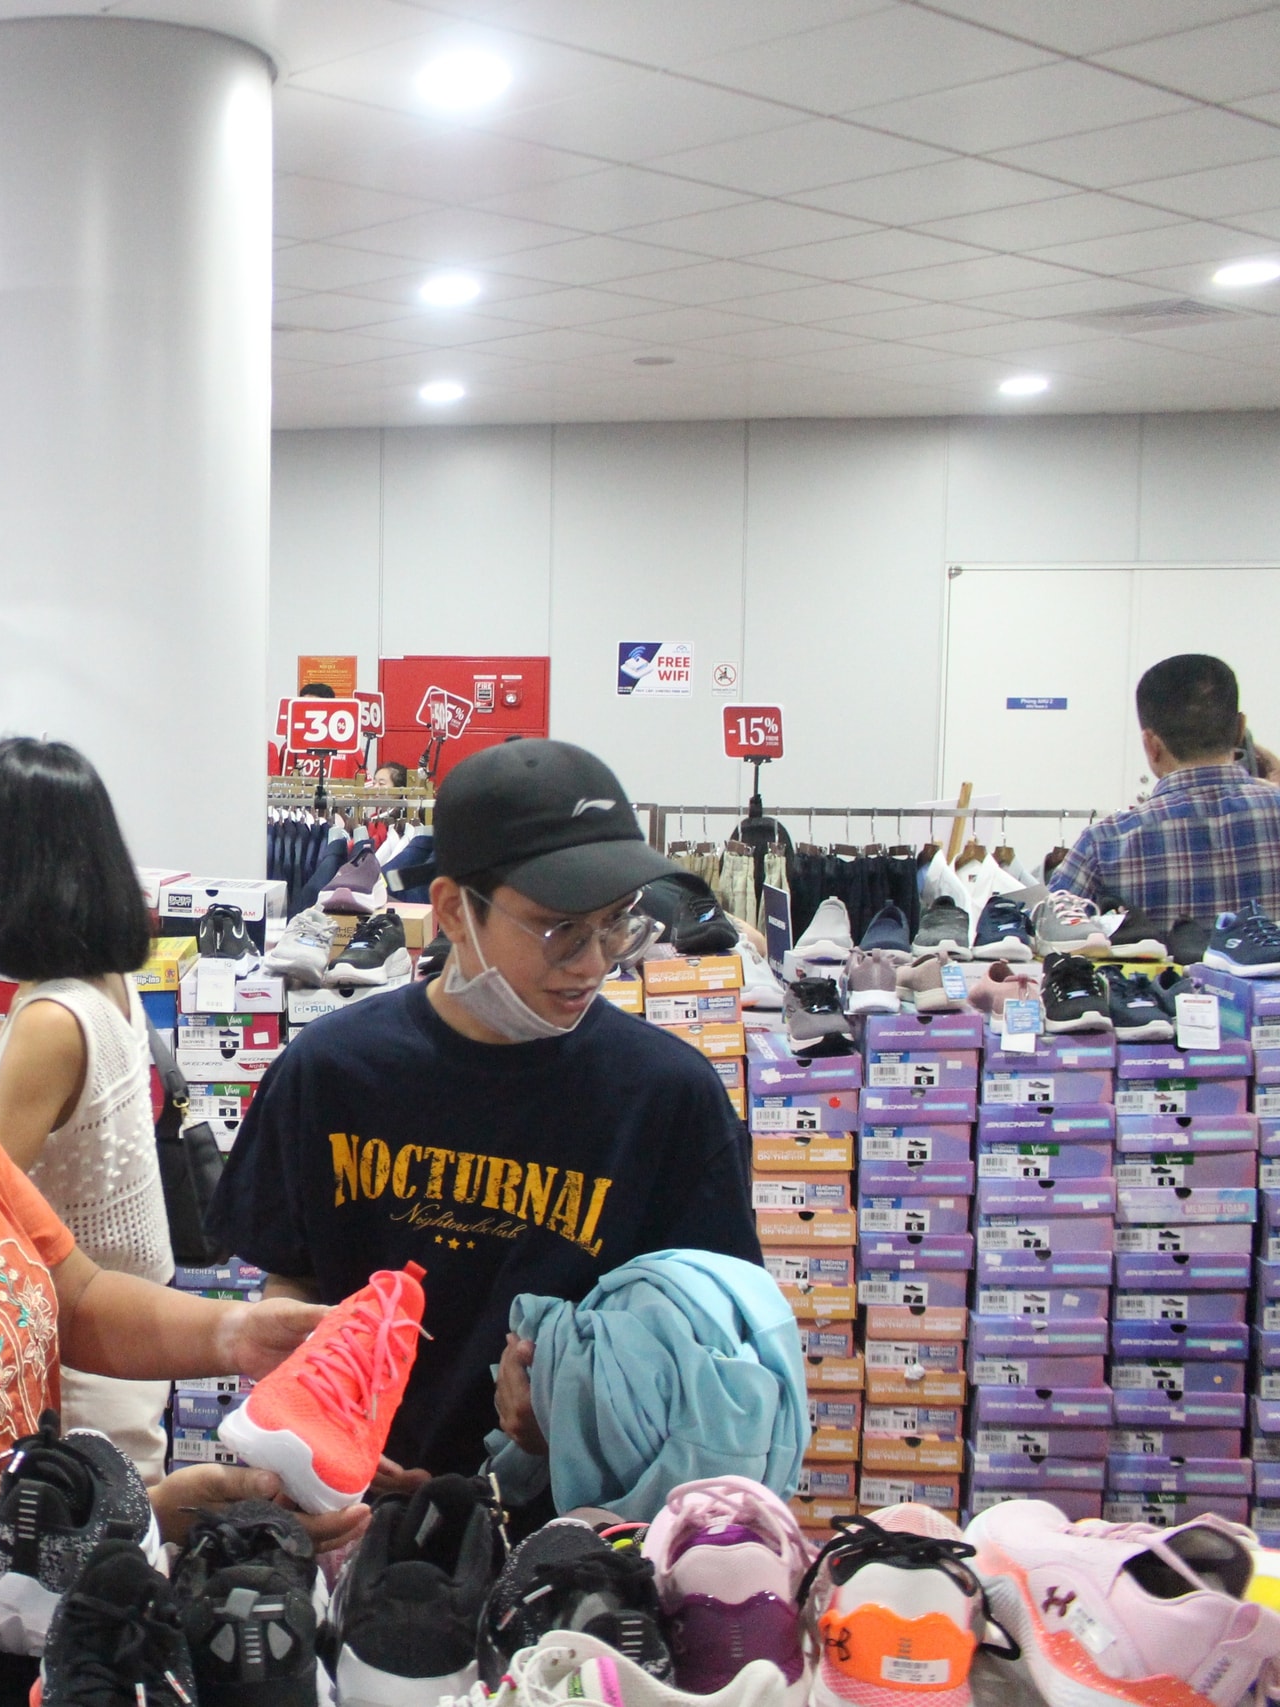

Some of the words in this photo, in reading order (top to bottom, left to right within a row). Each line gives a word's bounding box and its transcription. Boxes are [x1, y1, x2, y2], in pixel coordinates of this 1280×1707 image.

[657, 656, 691, 668] FREE
[657, 670, 690, 681] WIFI
[727, 715, 779, 747] -15%
[921, 1075, 928, 1085] 6
[913, 1149, 921, 1160] 6
[328, 1132, 613, 1258] NOCTURNAL
[911, 1221, 919, 1232] 6
